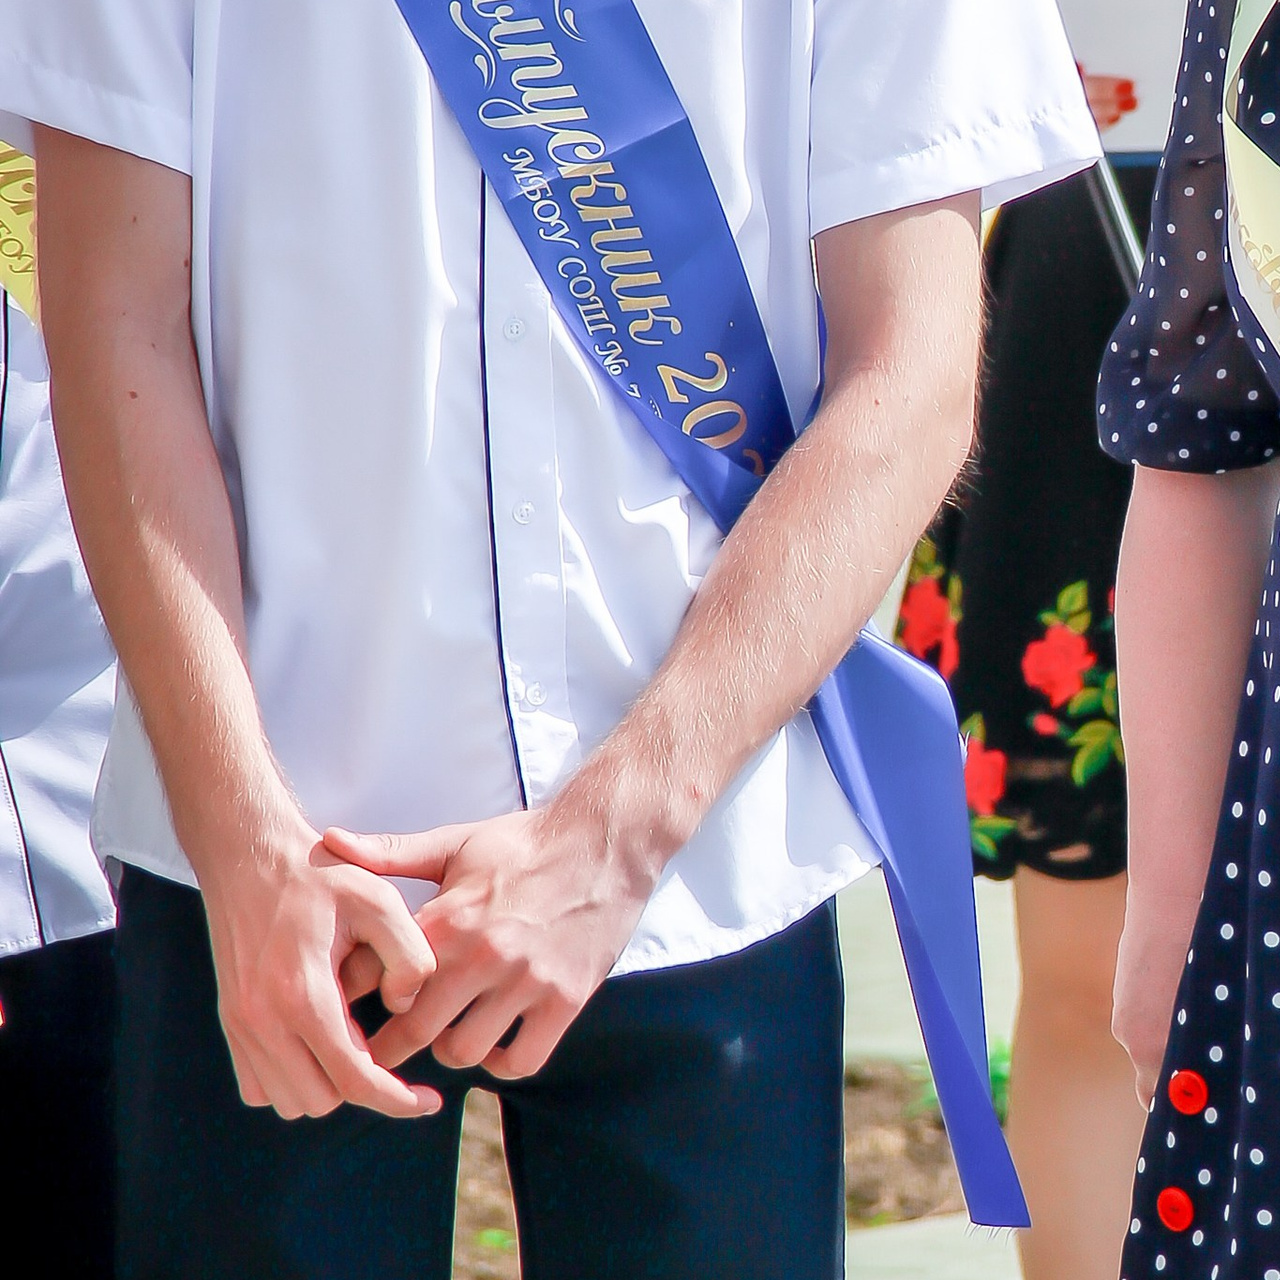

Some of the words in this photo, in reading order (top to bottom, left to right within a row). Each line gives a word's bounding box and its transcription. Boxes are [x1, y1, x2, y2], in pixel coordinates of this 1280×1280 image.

[502, 147, 580, 250] МБОУ
[556, 256, 617, 337] СОШ
[656, 351, 765, 477] 20
